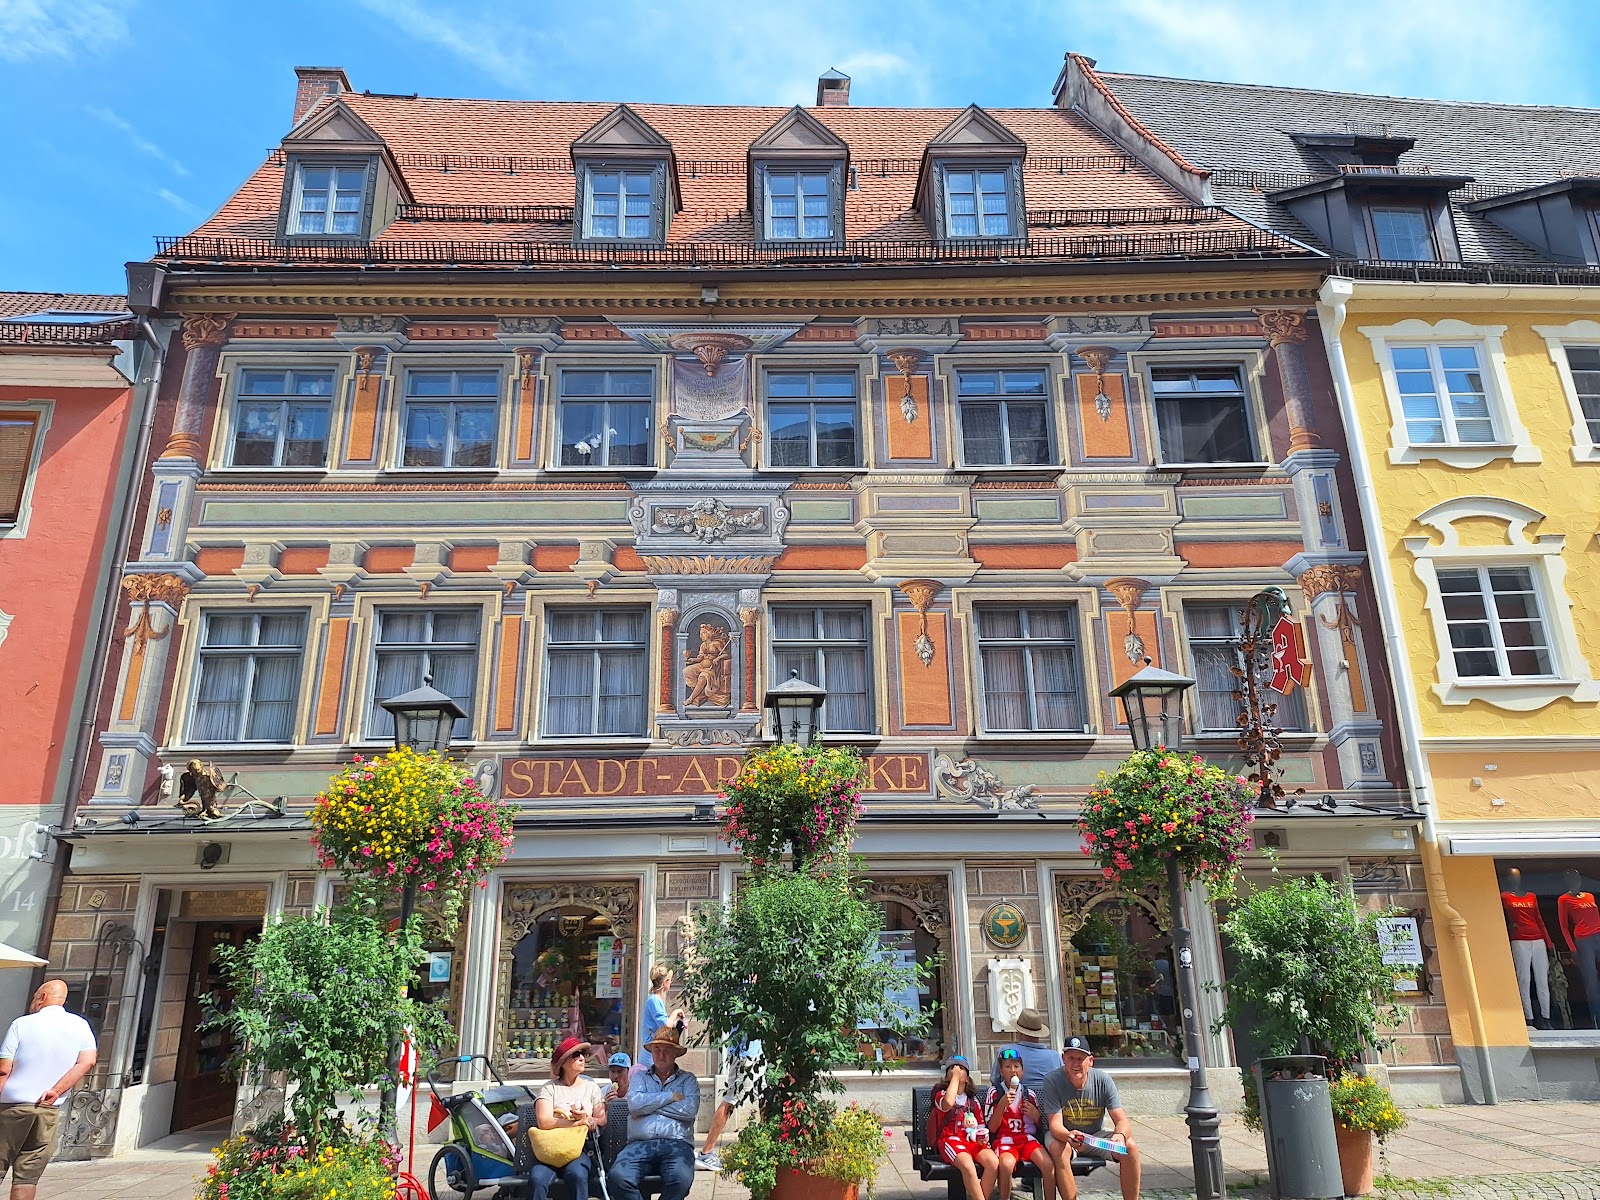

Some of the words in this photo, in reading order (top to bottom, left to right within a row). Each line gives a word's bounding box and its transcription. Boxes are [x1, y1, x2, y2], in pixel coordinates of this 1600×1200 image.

[504, 756, 927, 797] STADT-APKE
[11, 890, 36, 912] 14
[1512, 901, 1533, 909] SALE
